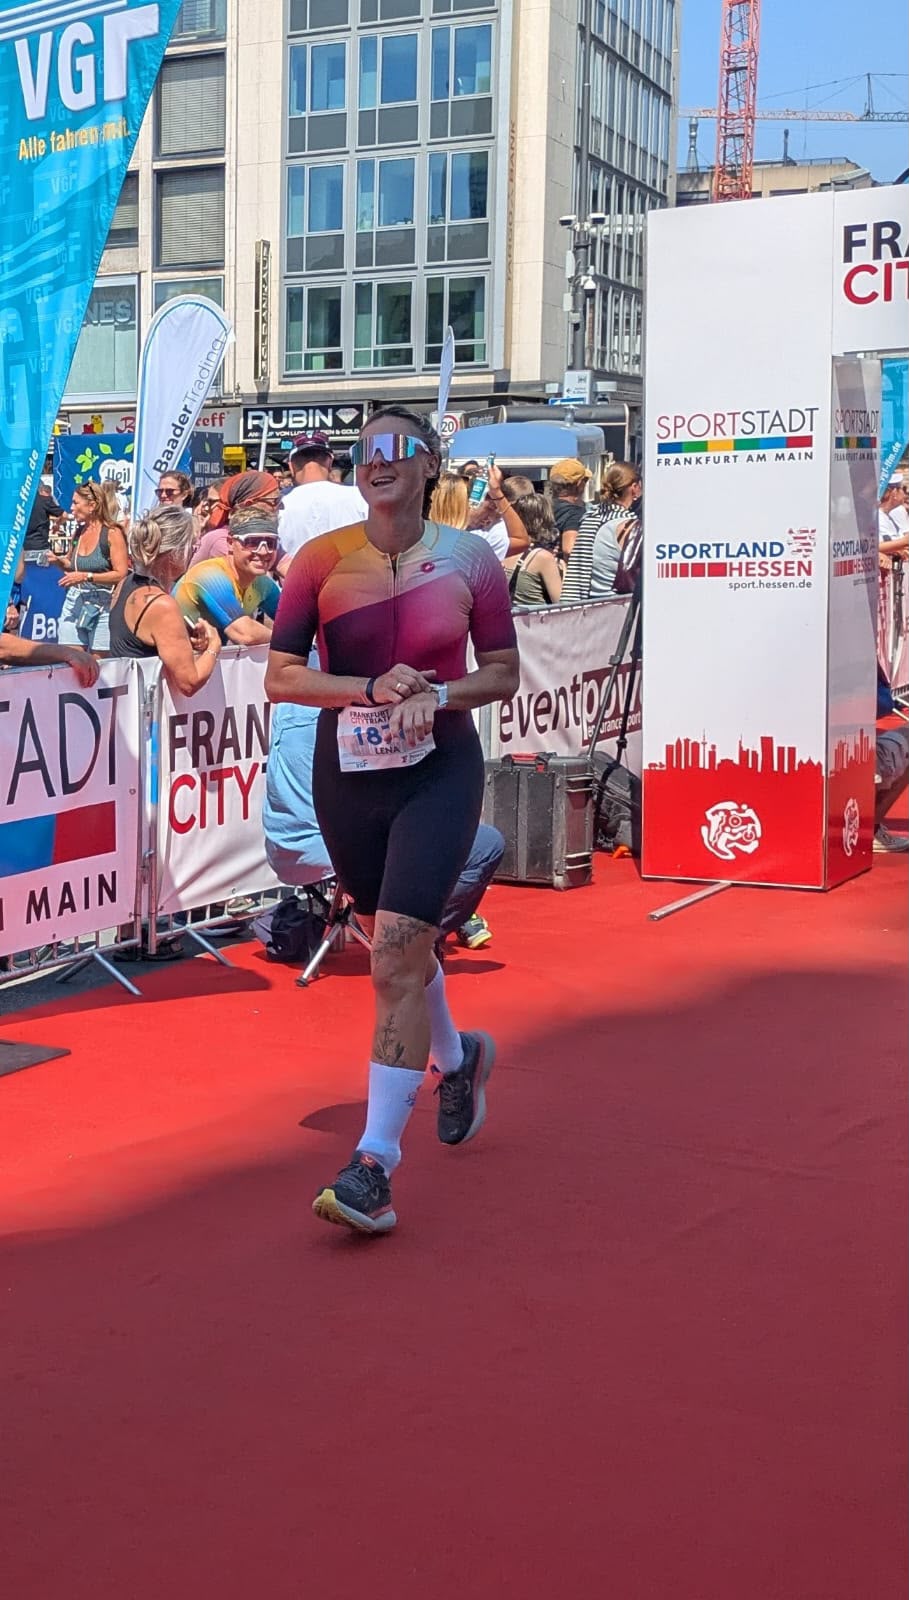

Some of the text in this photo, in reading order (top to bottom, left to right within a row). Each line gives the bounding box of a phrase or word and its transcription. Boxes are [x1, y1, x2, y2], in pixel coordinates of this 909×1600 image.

[18, 136, 46, 161] Alle
[50, 126, 98, 153] fahren
[88, 301, 132, 323] NES
[247, 408, 333, 430] RUBIN
[441, 421, 454, 432] 20
[656, 407, 819, 440] SPORTSTADT
[656, 451, 813, 467] FRANKFURT AM MAIN
[2, 449, 39, 576] www.vgf-ffm.de
[655, 541, 785, 560] SPORTLAND
[832, 539, 869, 558] SPORTLAND
[729, 560, 813, 578] HESSEN
[728, 579, 813, 592] sport.hessen.de
[169, 701, 271, 773] FRAN
[375, 747, 400, 755] LENA
[169, 762, 266, 834] CITY
[26, 870, 117, 925] MAIN
